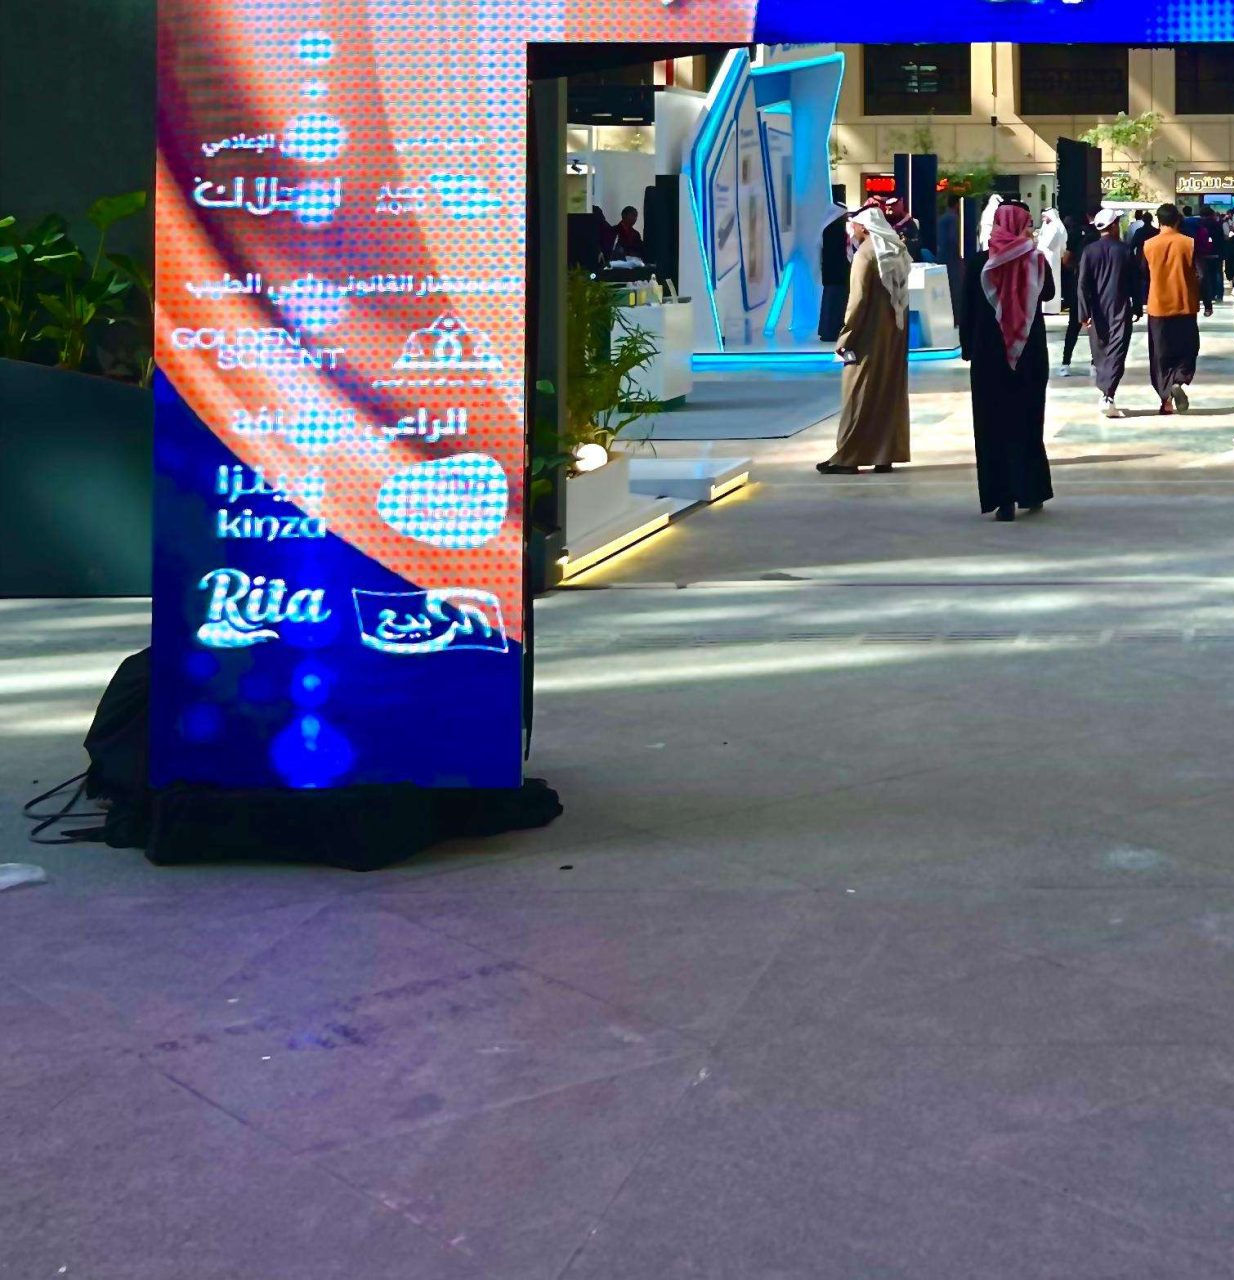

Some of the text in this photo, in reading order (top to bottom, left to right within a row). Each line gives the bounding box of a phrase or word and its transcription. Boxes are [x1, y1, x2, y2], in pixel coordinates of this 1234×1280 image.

[171, 327, 300, 349] GOLDEN
[217, 508, 327, 542] kinza
[198, 567, 332, 632] Rita
